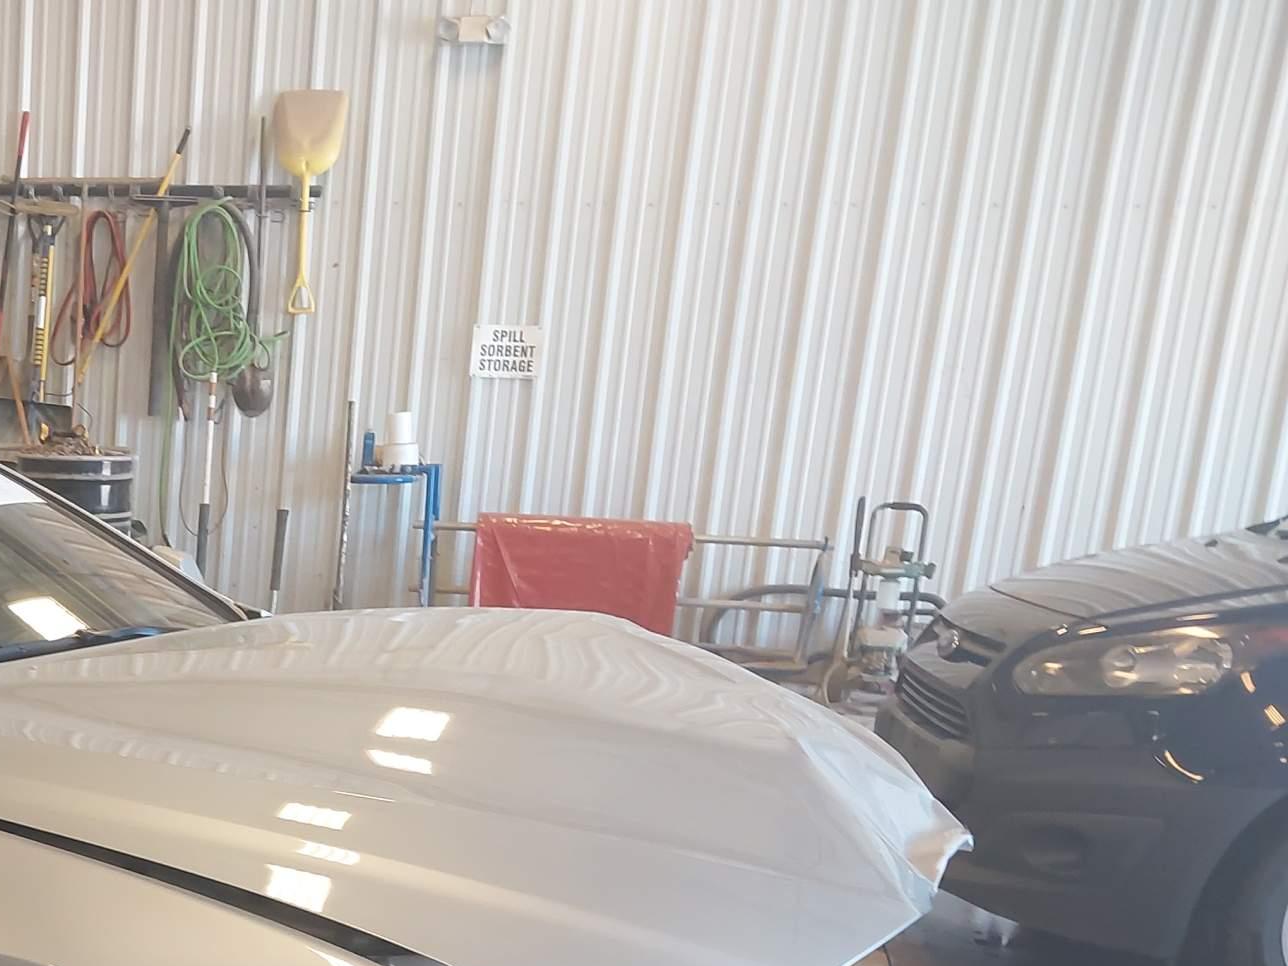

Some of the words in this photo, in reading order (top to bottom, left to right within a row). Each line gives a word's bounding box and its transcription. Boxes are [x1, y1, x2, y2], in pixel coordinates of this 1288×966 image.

[492, 329, 526, 343] SPILL
[479, 344, 537, 358] SORBENT
[478, 358, 534, 373] STORAGE
